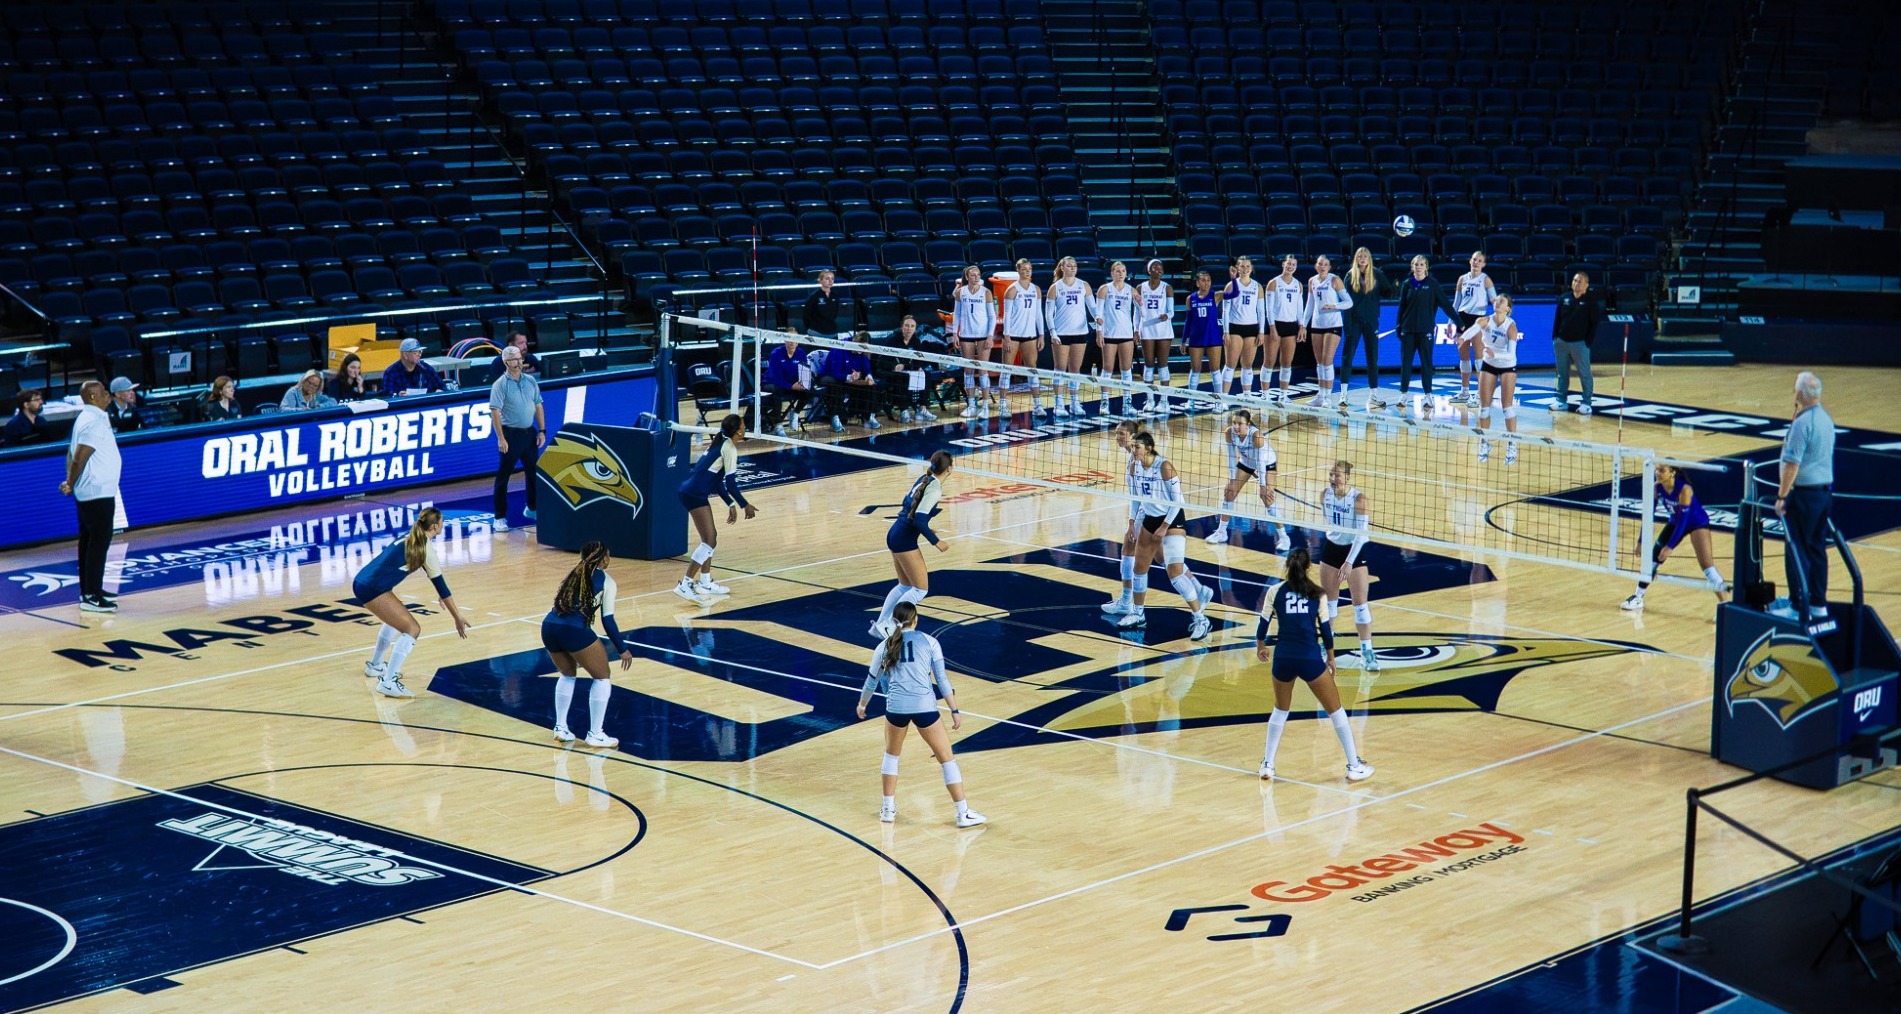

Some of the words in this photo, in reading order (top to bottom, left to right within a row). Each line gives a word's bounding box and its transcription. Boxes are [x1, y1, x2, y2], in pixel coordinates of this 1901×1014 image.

[1316, 292, 1322, 300] 4
[1465, 287, 1474, 296] 21
[1066, 296, 1078, 305] 24
[1241, 296, 1251, 305] 16
[1286, 293, 1292, 302] 9
[1024, 299, 1032, 308] 17
[1115, 301, 1121, 310] 2
[1147, 300, 1159, 309] 23
[1197, 307, 1207, 317] 10
[1491, 335, 1497, 343] 7
[695, 367, 712, 376] ORU
[202, 428, 308, 478] ORAL
[318, 402, 493, 462] ROBERTS
[269, 452, 434, 497] VOLLEYBALL
[1141, 482, 1150, 495] 12
[1333, 512, 1341, 525] 11
[1285, 591, 1308, 613] 22
[901, 641, 915, 663] 11
[1854, 686, 1882, 713] ORU
[155, 811, 446, 887] SUMMIT
[1250, 823, 1525, 902] Gateway
[278, 865, 348, 886] THE
[1351, 875, 1434, 903] BANKING
[1433, 844, 1529, 878] MORTGAGE
